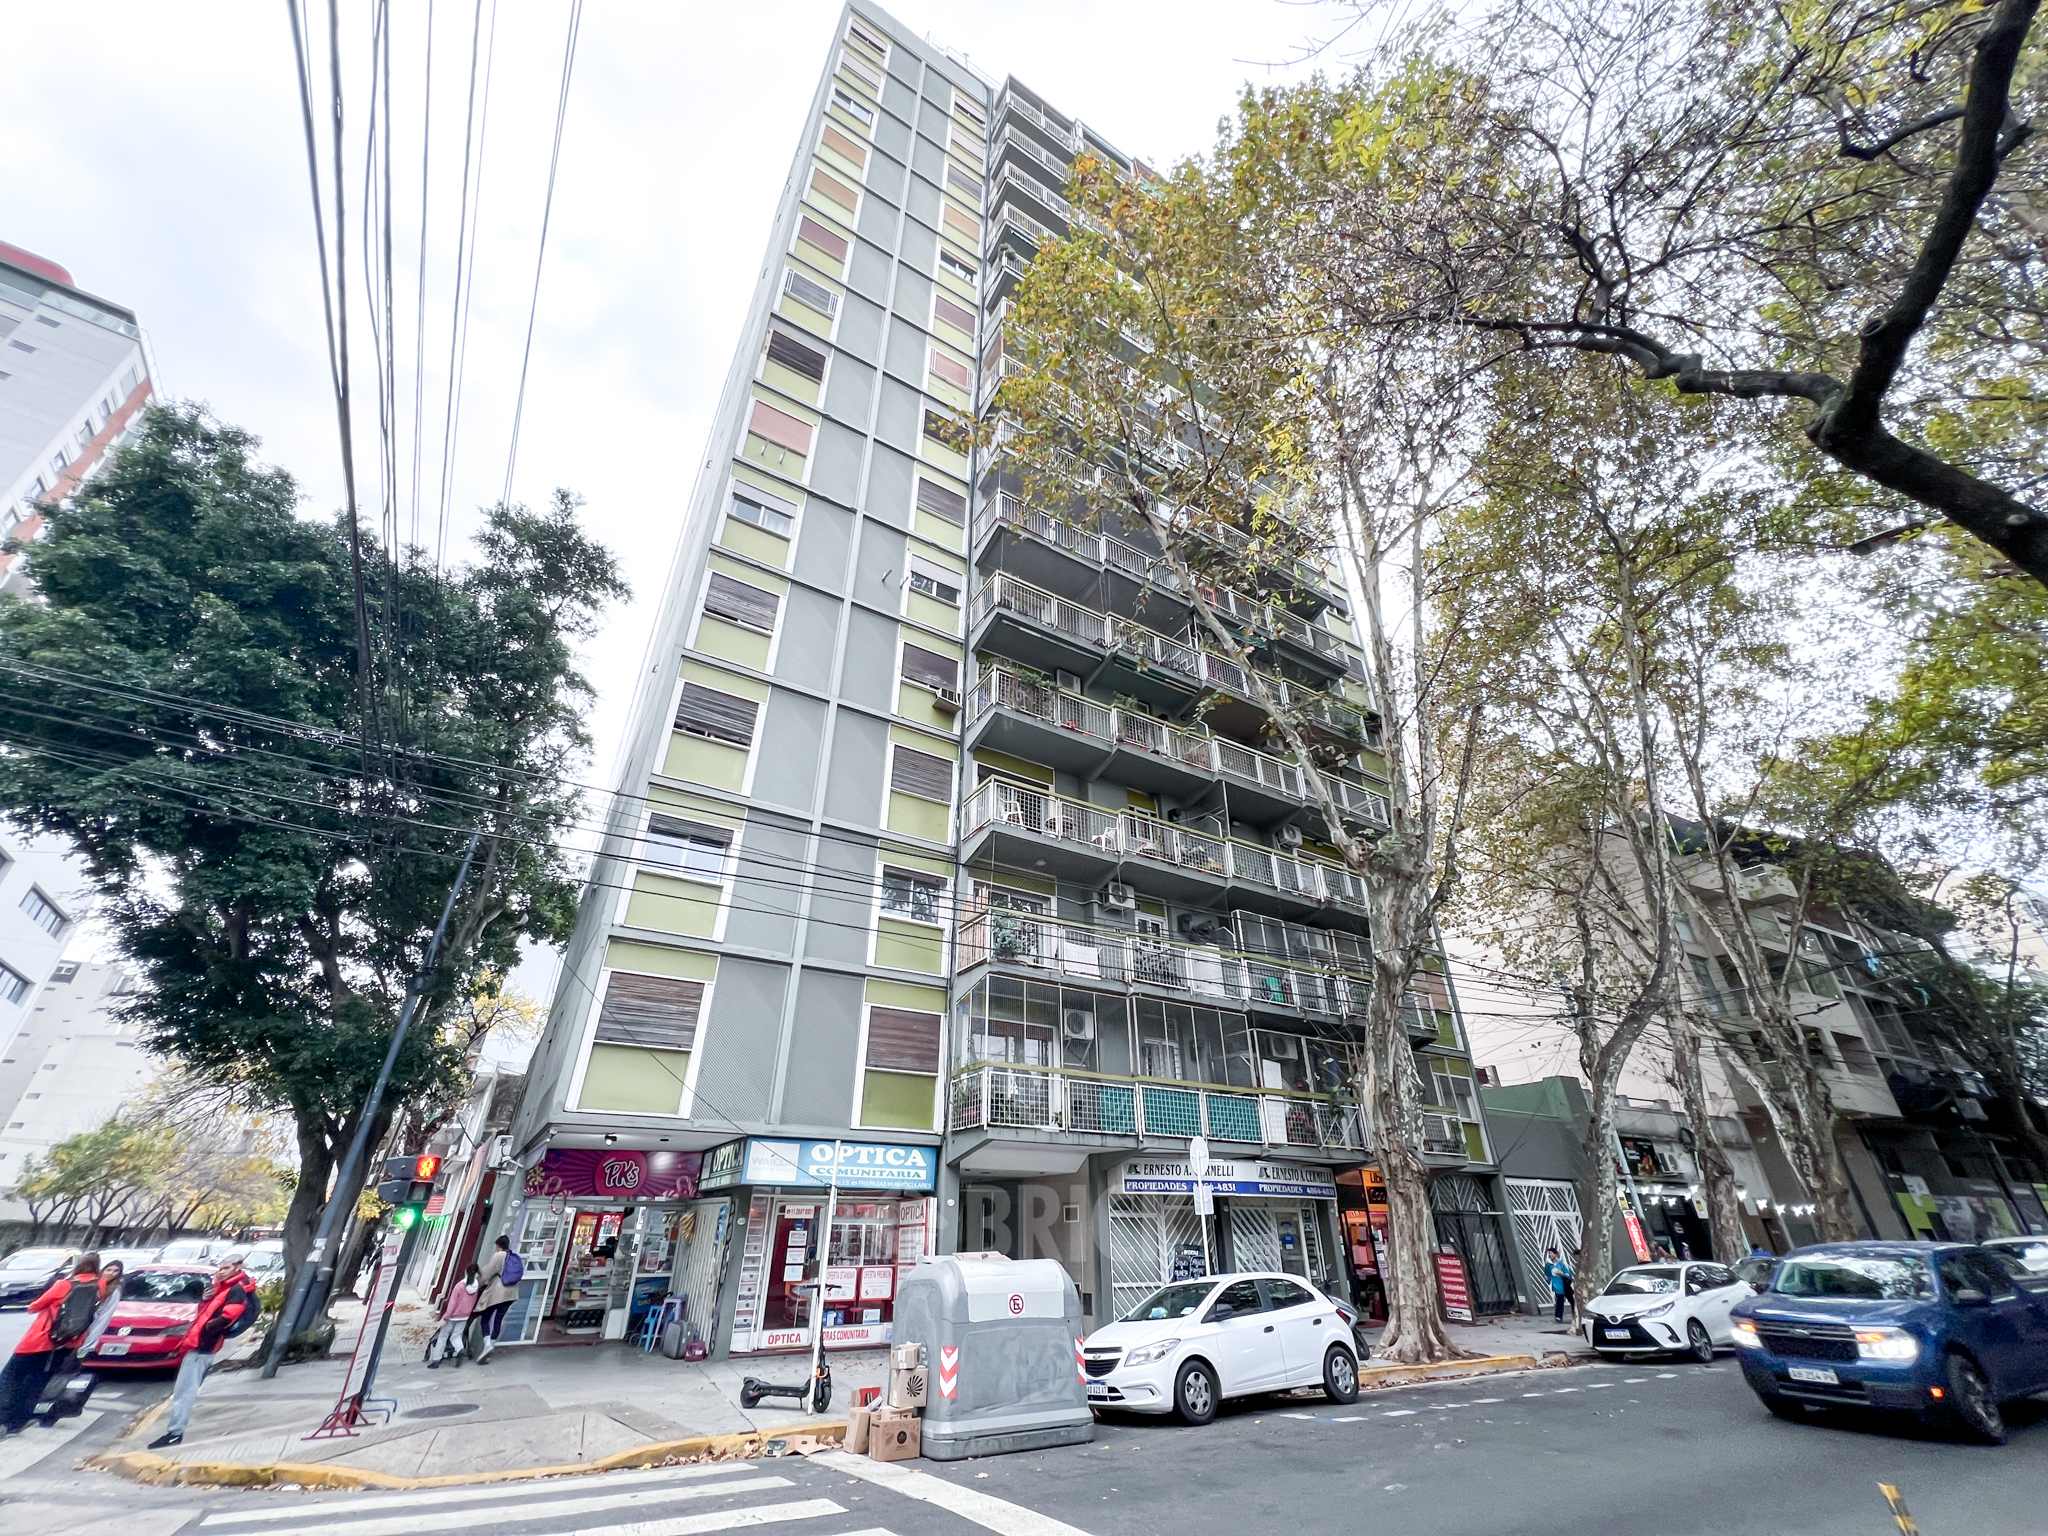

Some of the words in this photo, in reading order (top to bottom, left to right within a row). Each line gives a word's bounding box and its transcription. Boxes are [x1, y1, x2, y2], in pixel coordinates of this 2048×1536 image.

[811, 1143, 928, 1167] OPTICA
[816, 1167, 922, 1178] COMUNITARIA
[1143, 1164, 1182, 1176] ERNESTO
[1126, 1181, 1187, 1191] PROPIEDADES
